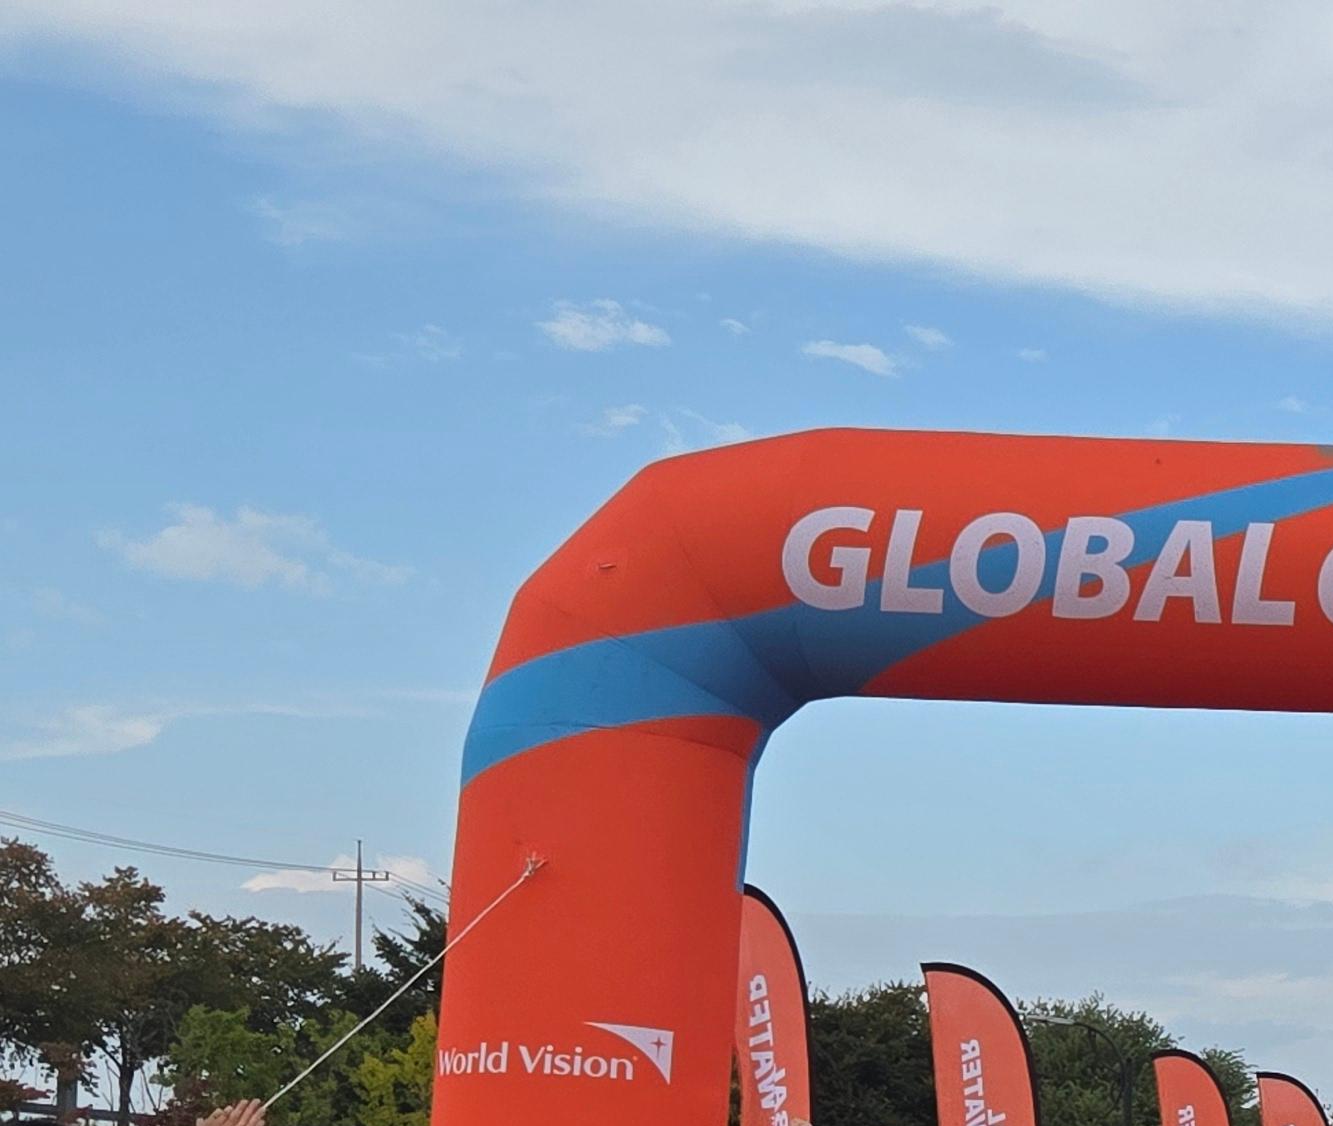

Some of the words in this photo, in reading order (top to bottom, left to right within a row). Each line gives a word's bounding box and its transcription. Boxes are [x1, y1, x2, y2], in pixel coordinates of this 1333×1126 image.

[782, 506, 1296, 627] GLOBAL
[439, 1041, 509, 1077] World
[519, 1044, 634, 1081] Vision
